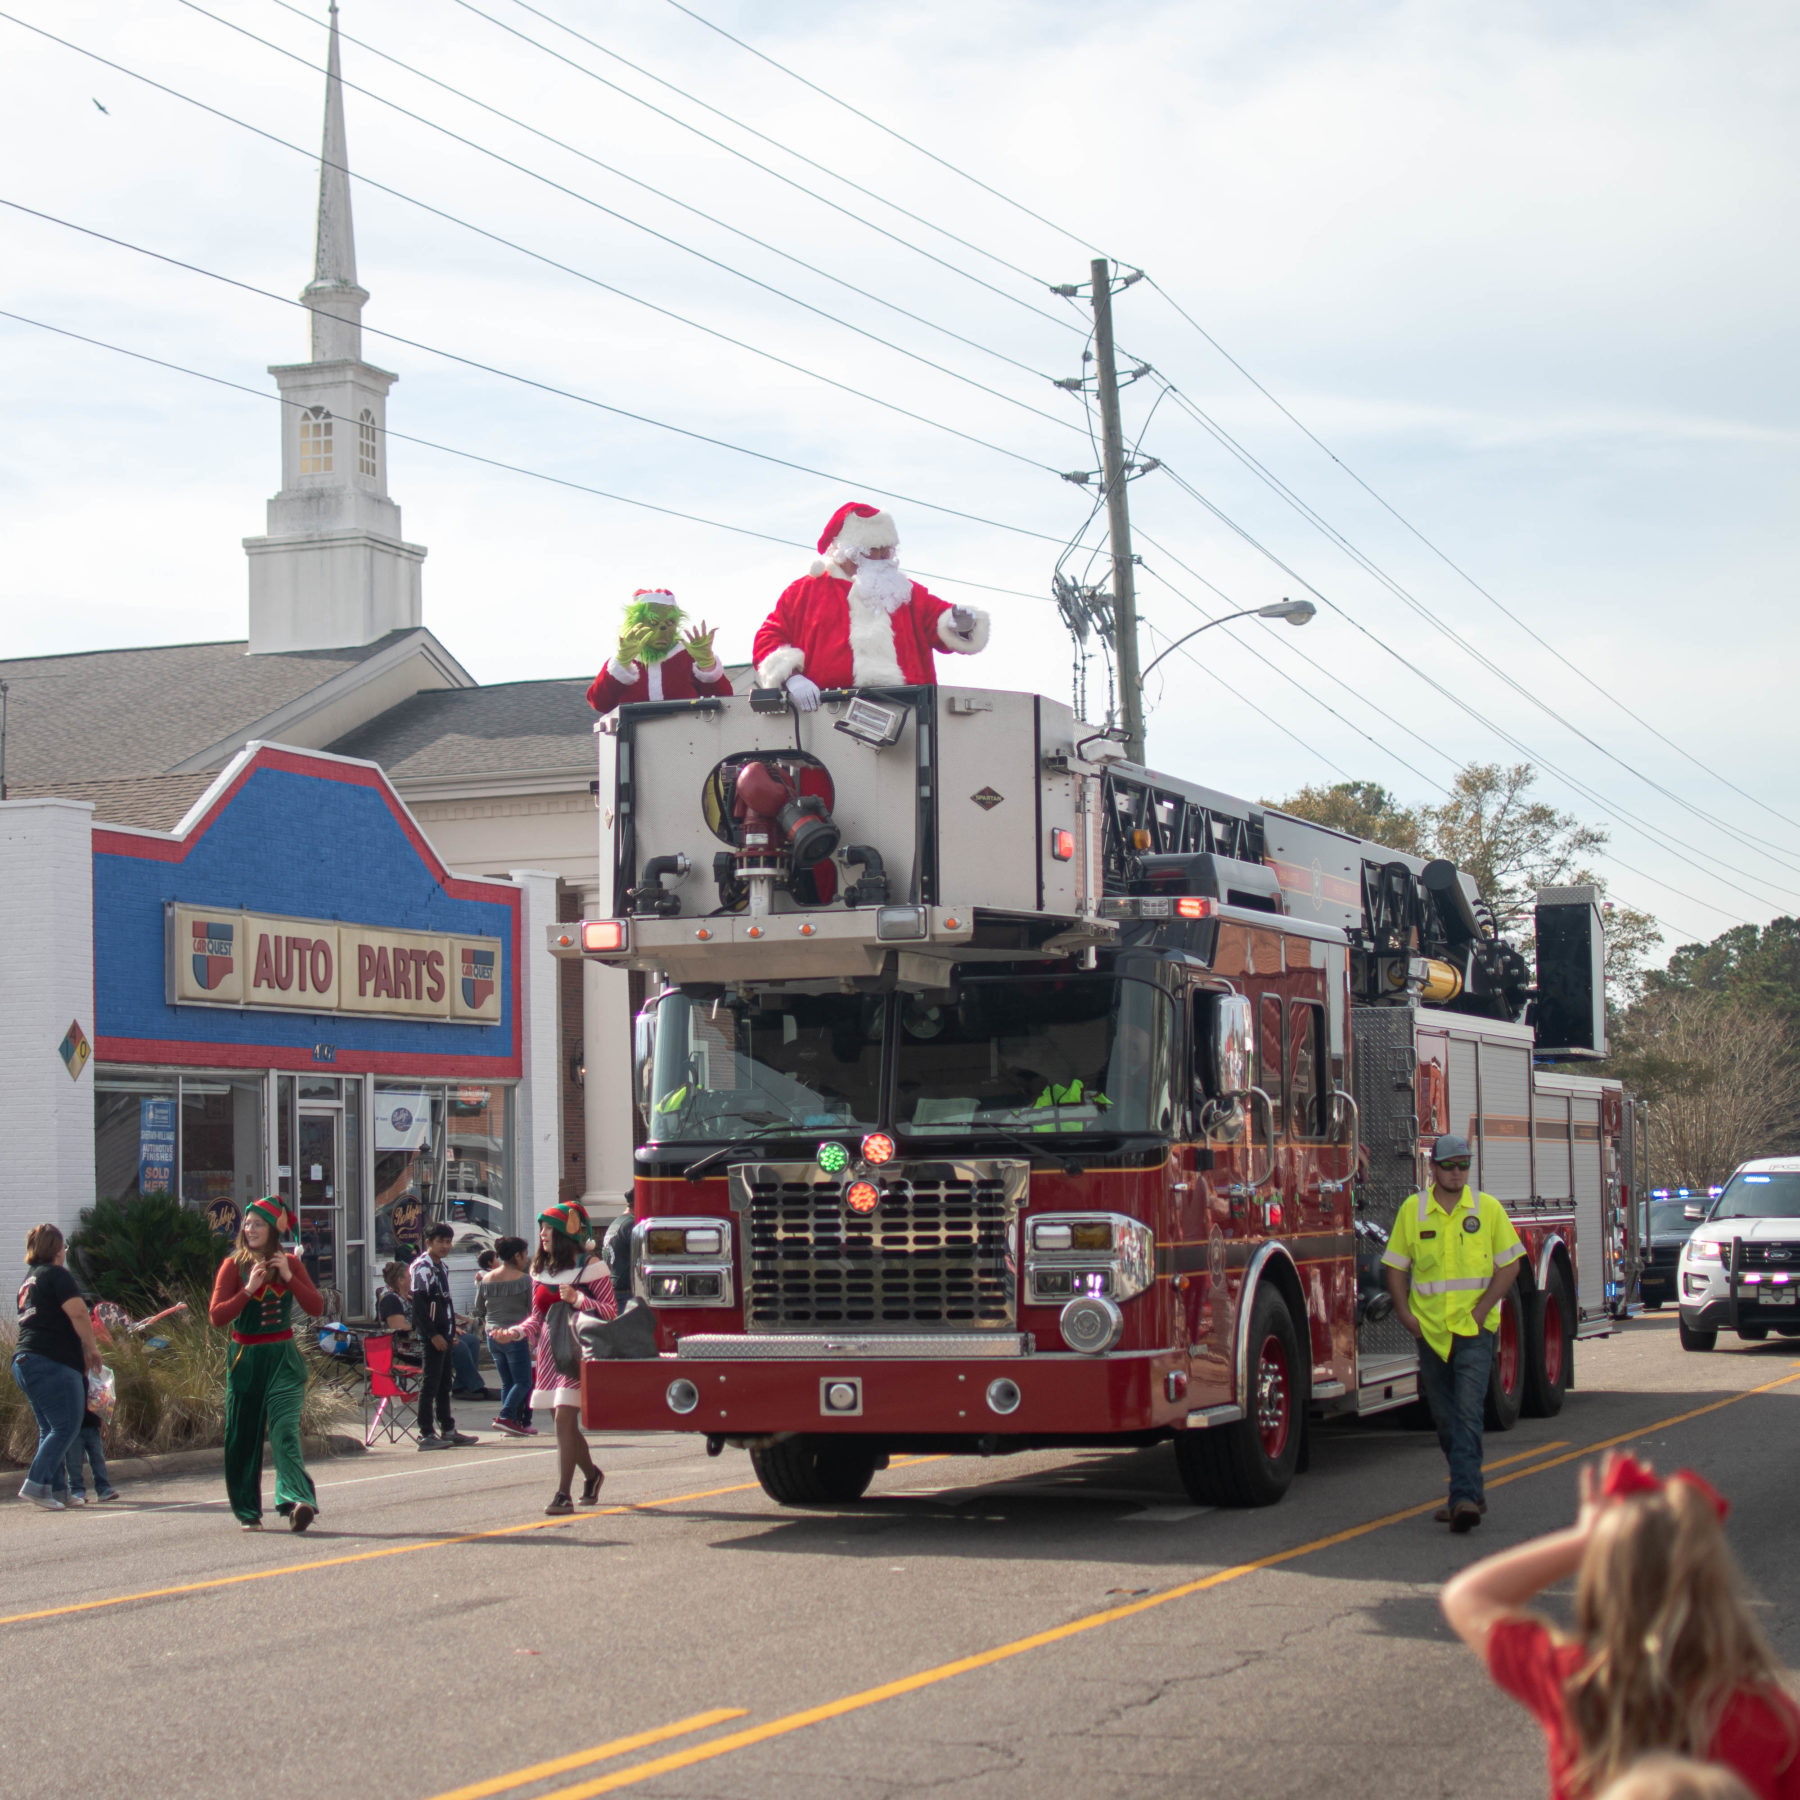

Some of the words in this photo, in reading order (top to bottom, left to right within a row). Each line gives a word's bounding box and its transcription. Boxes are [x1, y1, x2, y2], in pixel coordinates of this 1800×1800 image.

[253, 933, 333, 993] AUTO
[358, 943, 446, 1002] PARTS
[80, 1040, 86, 1058] 0
[142, 1144, 173, 1152] AUTOMOTIVE
[142, 1152, 173, 1161] FINISHES
[145, 1167, 169, 1179] SOLD
